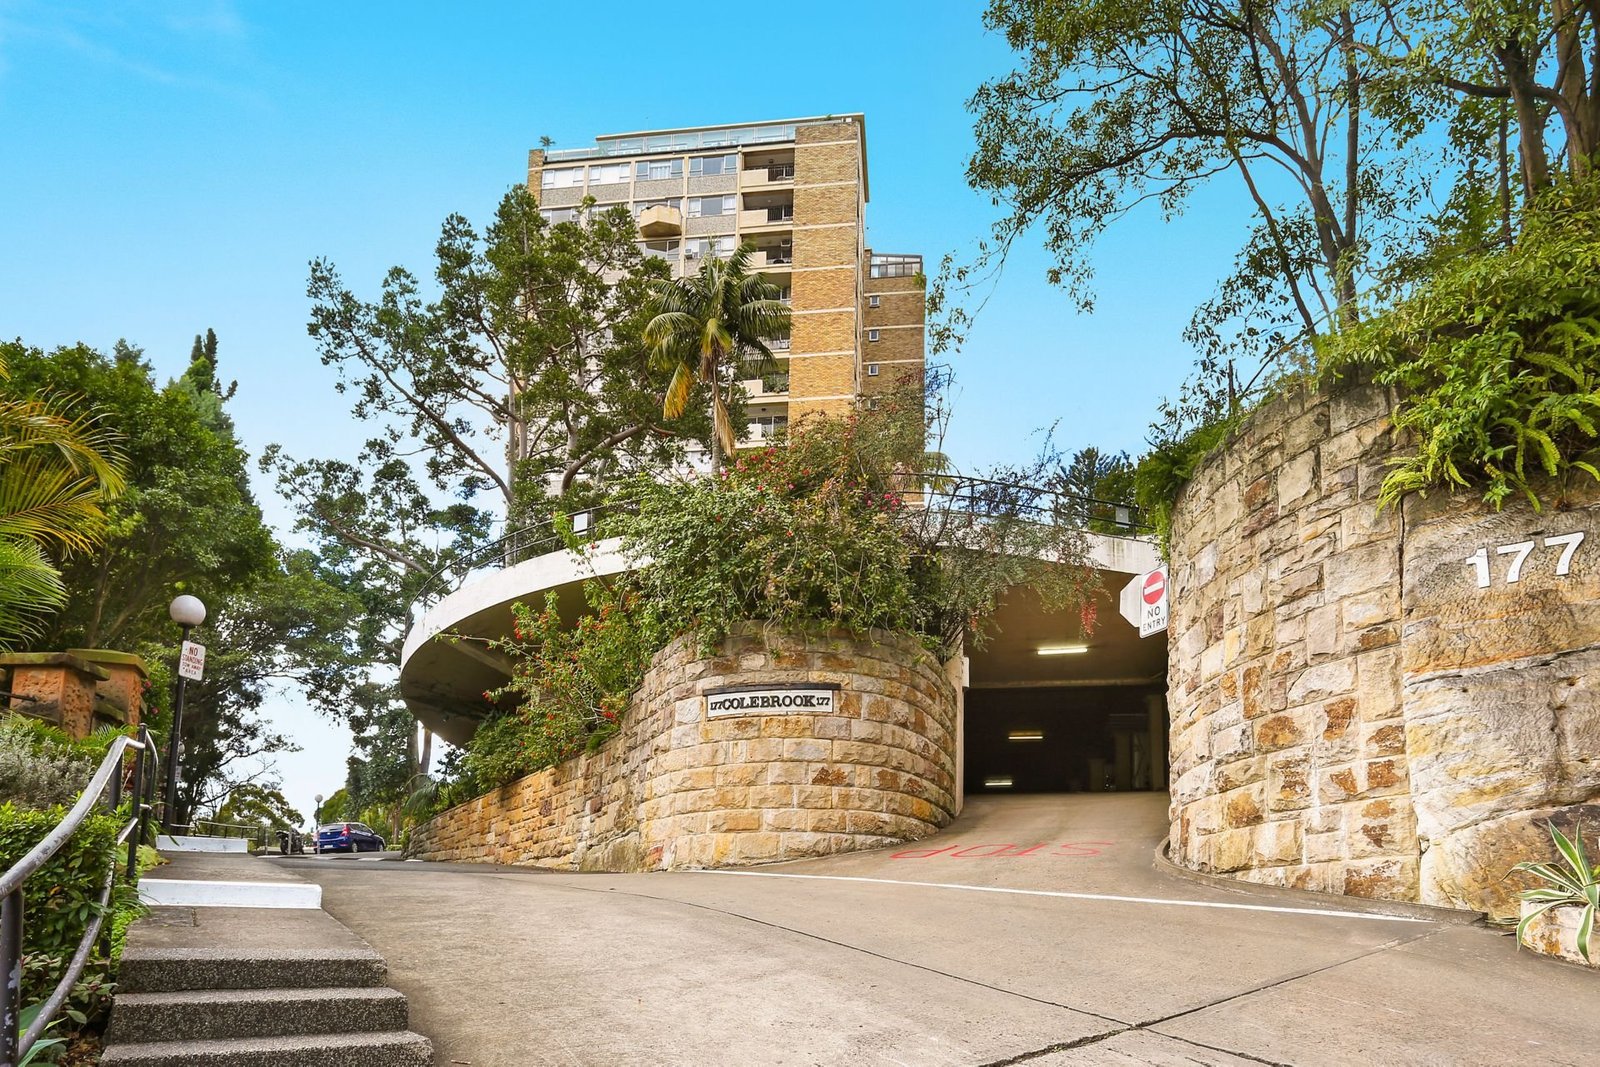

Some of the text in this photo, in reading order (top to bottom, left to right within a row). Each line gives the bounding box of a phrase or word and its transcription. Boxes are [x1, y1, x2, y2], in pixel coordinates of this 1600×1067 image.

[1465, 531, 1585, 588] 177
[1147, 605, 1161, 619] NO
[1142, 616, 1165, 631] ENTRY
[189, 646, 198, 656] NO
[181, 653, 203, 666] STANDING
[722, 695, 816, 710] COLEBROOK
[816, 696, 831, 706] 177
